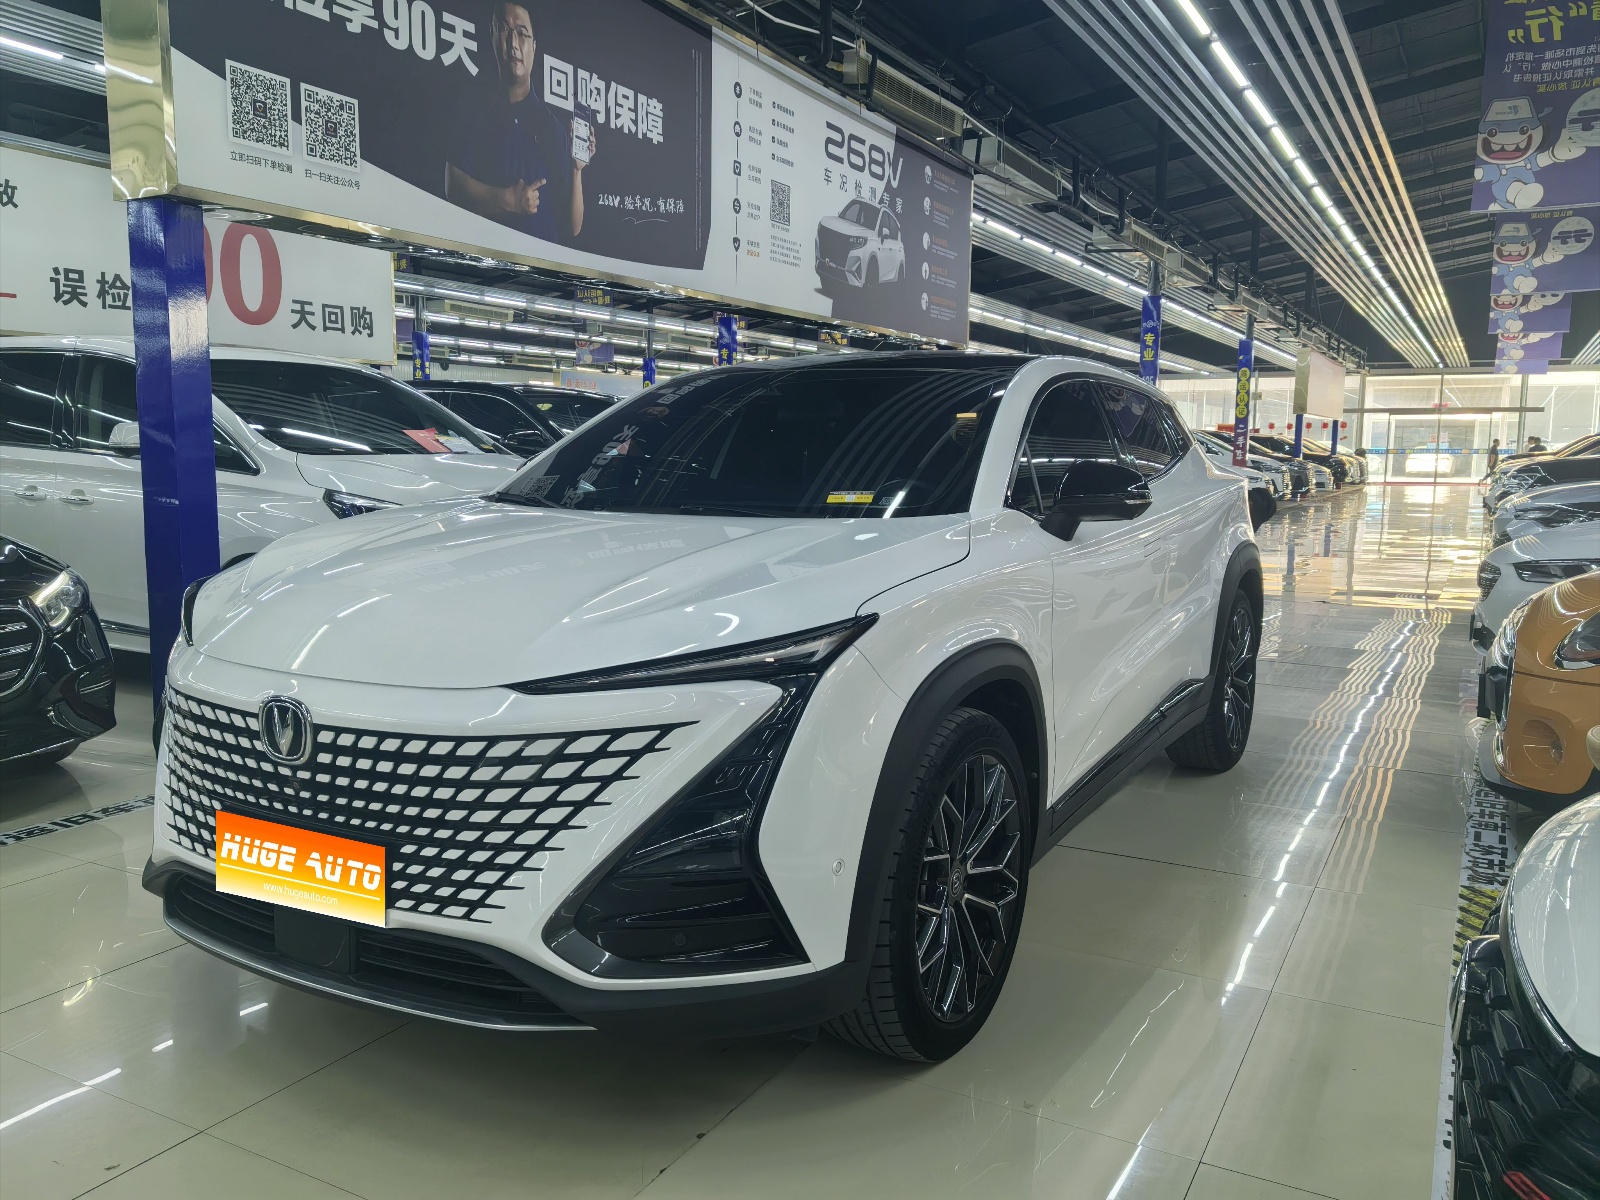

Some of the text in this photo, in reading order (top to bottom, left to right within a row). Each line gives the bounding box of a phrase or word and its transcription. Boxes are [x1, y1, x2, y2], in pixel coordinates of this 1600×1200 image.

[543, 53, 664, 145] 回购保障
[230, 150, 293, 174] 立即扫码下单检测
[824, 120, 904, 189] 268V
[304, 168, 361, 190] 扫一扫关注公众号
[823, 166, 904, 214] 车况检测专家
[50, 266, 132, 310] 误检
[290, 298, 374, 338] 天回购
[1143, 332, 1155, 361] 专业
[1236, 424, 1247, 461] 二手车
